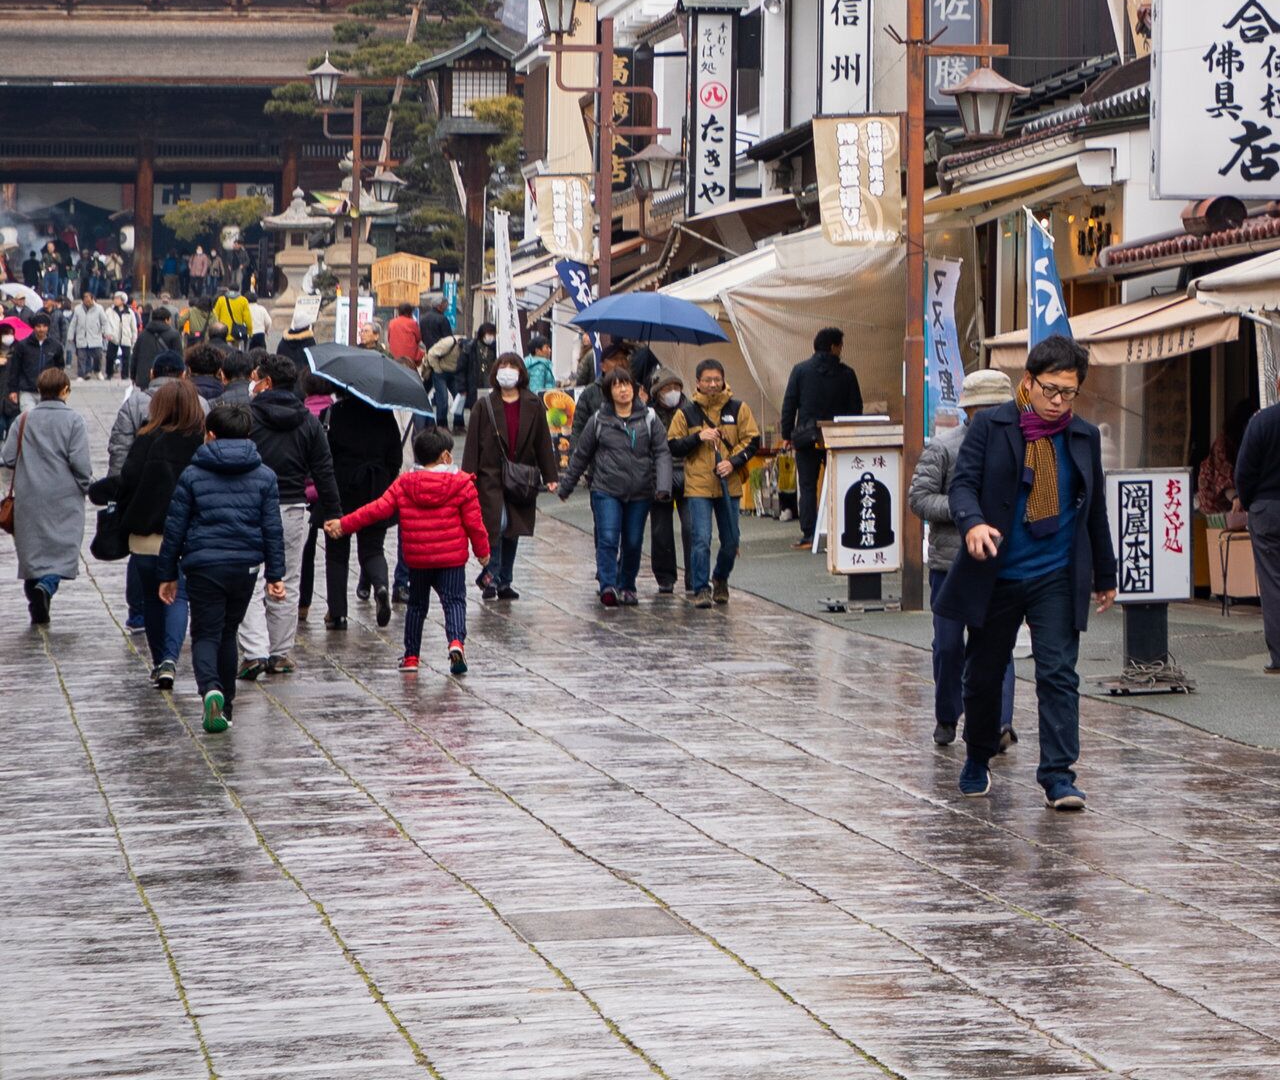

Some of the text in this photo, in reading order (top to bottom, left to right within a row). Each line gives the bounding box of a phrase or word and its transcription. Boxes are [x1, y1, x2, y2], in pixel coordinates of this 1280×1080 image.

[1203, 41, 1245, 120] 佛具
[698, 115, 725, 205] たきや
[852, 552, 886, 565] 仏具
[1122, 484, 1150, 591] 滝屋本店
